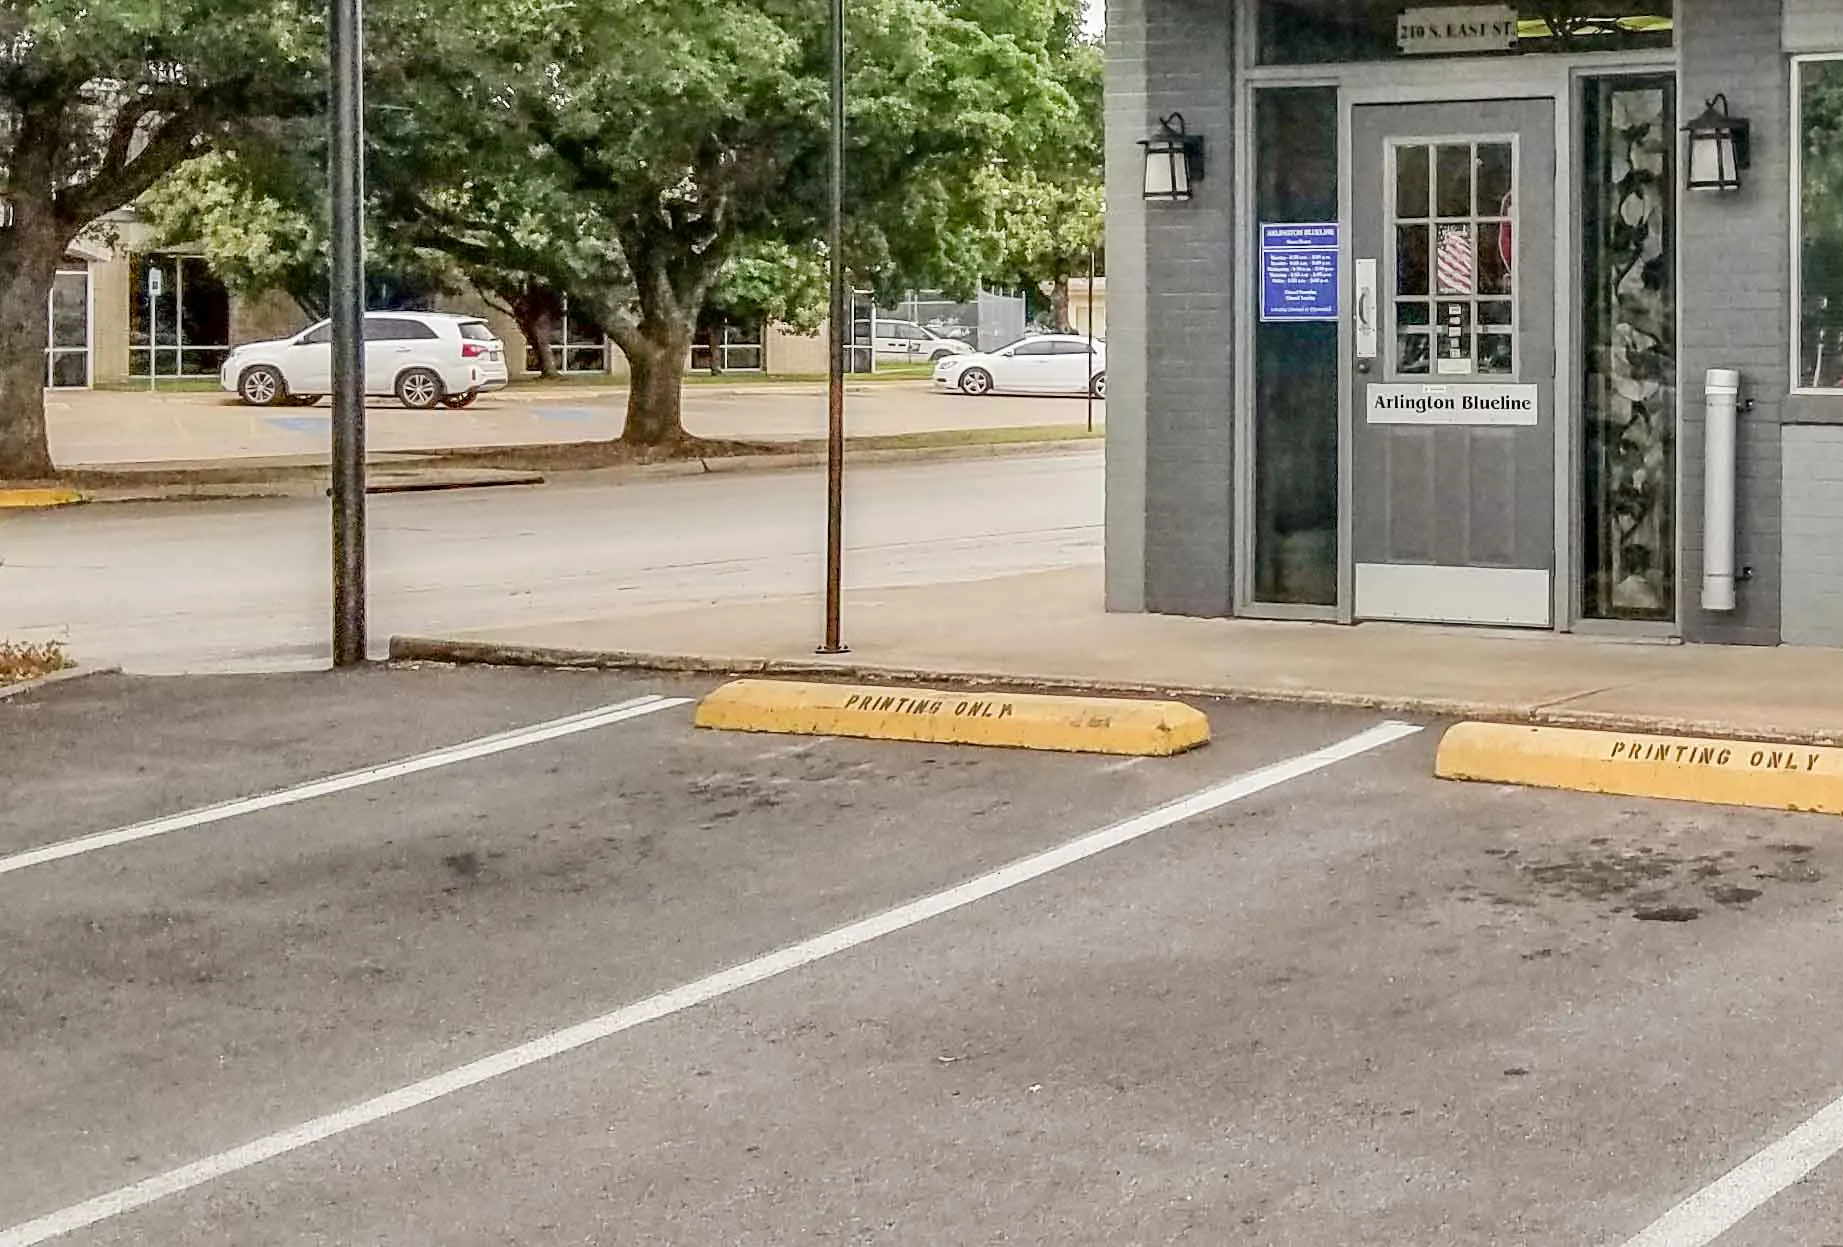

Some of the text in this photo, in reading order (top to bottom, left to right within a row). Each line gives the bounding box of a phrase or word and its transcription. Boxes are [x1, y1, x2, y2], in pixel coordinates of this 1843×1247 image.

[1446, 22, 1486, 38] EAST
[1374, 394, 1532, 413] Arlington Blueline
[843, 694, 944, 715] PRINTING
[1610, 741, 1821, 771] PRINTING ONLY
